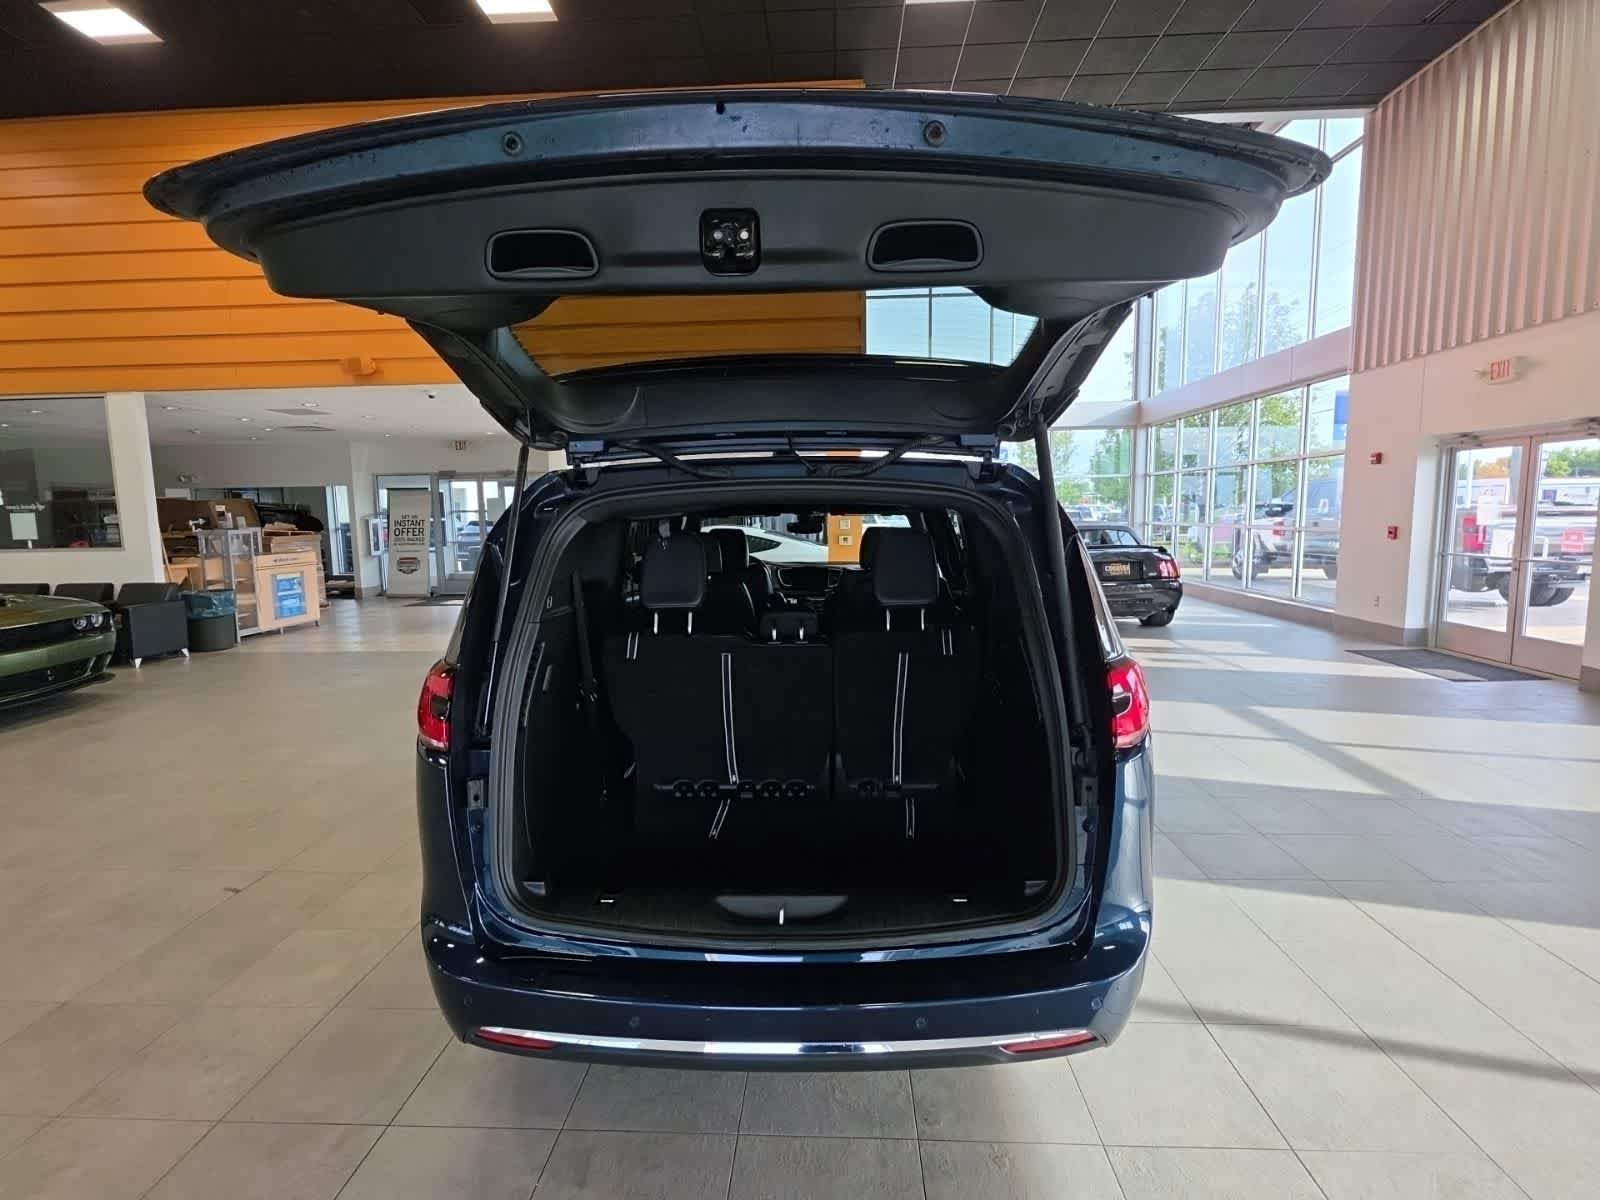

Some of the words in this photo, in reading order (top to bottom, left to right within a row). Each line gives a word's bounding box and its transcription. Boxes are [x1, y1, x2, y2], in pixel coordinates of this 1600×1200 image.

[1490, 360, 1510, 380] EXIT
[394, 519, 425, 527] INSTANT
[394, 527, 425, 536] OFFER
